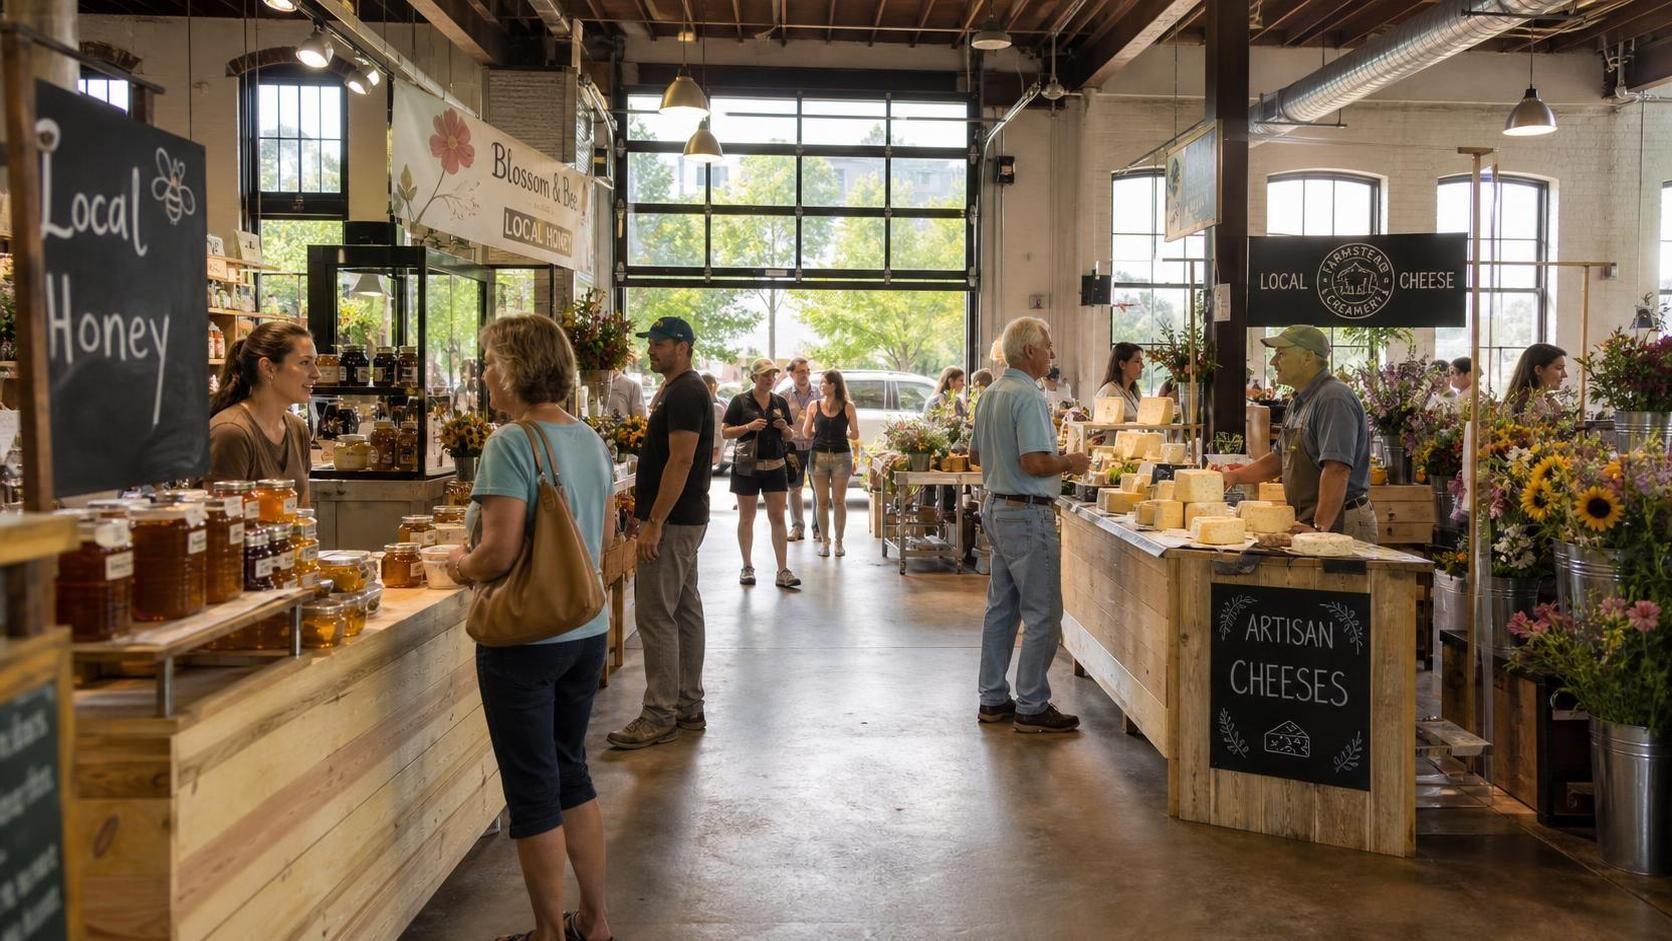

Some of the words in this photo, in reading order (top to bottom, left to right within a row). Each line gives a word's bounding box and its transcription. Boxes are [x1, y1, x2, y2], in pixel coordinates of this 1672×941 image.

[35, 118, 148, 257] Local
[491, 142, 550, 197] Blossom
[552, 173, 561, 203] &
[563, 175, 578, 211] Bee
[505, 212, 543, 244] LOCAL
[1322, 246, 1389, 274] FARMSTEAD
[1260, 271, 1308, 290] LOCAL
[1400, 271, 1455, 289] CHEESE
[1326, 294, 1384, 316] CREAMERY
[46, 272, 170, 426] Honey
[1245, 613, 1334, 649] ARTISAN
[1229, 659, 1349, 707] CHEESES
